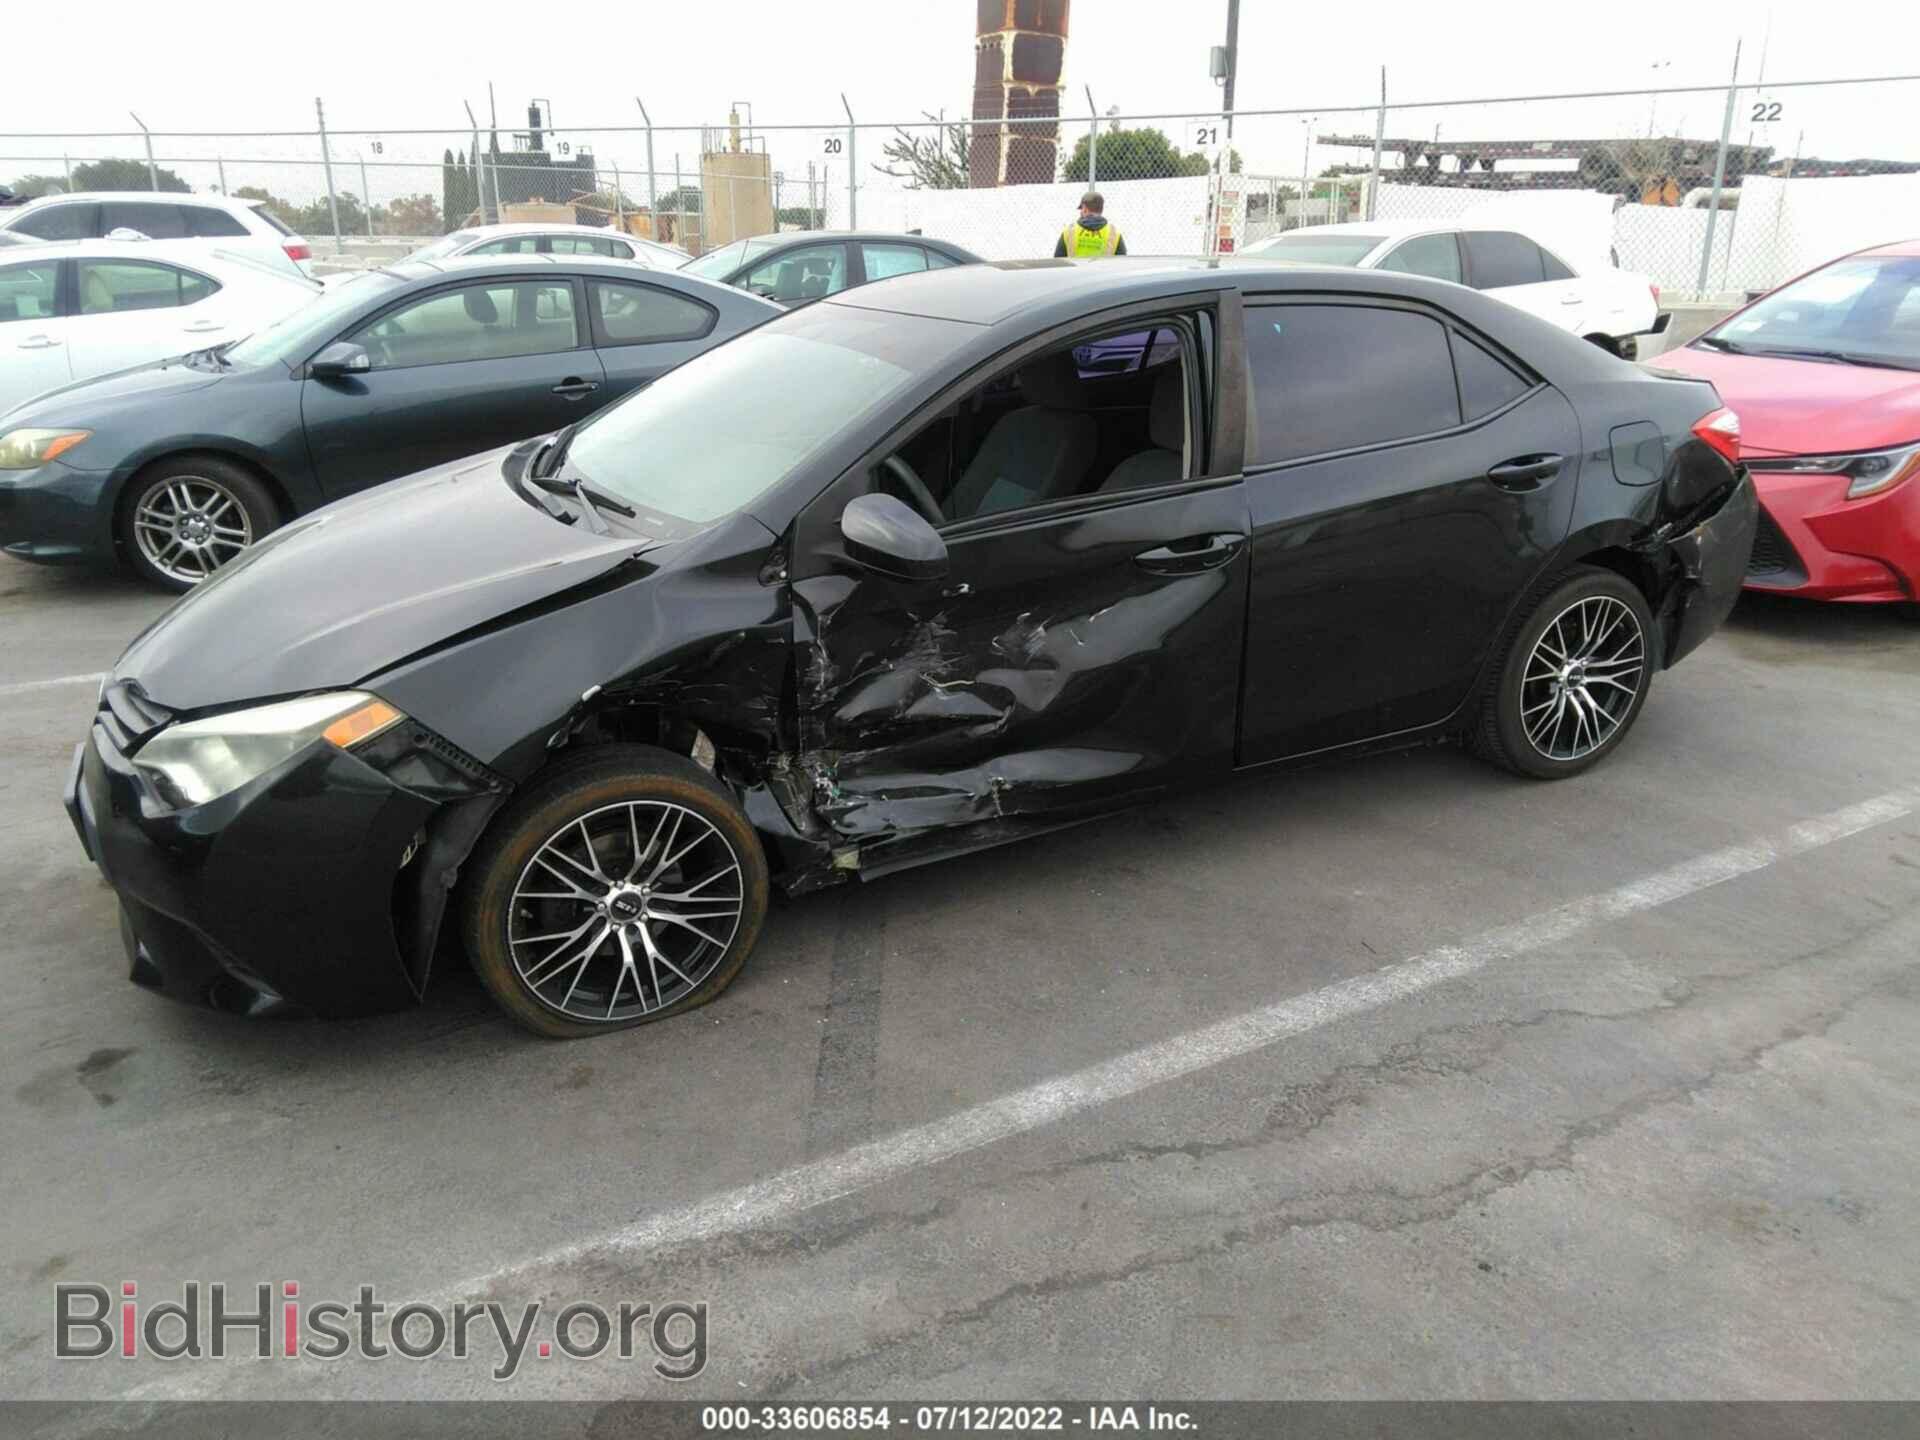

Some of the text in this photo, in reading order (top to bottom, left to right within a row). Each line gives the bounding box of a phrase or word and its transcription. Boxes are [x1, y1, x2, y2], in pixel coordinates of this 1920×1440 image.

[1752, 102, 1783, 122] 22
[1195, 127, 1217, 145] 21
[371, 142, 383, 154] 18
[557, 141, 570, 155] 19
[824, 138, 842, 154] 20
